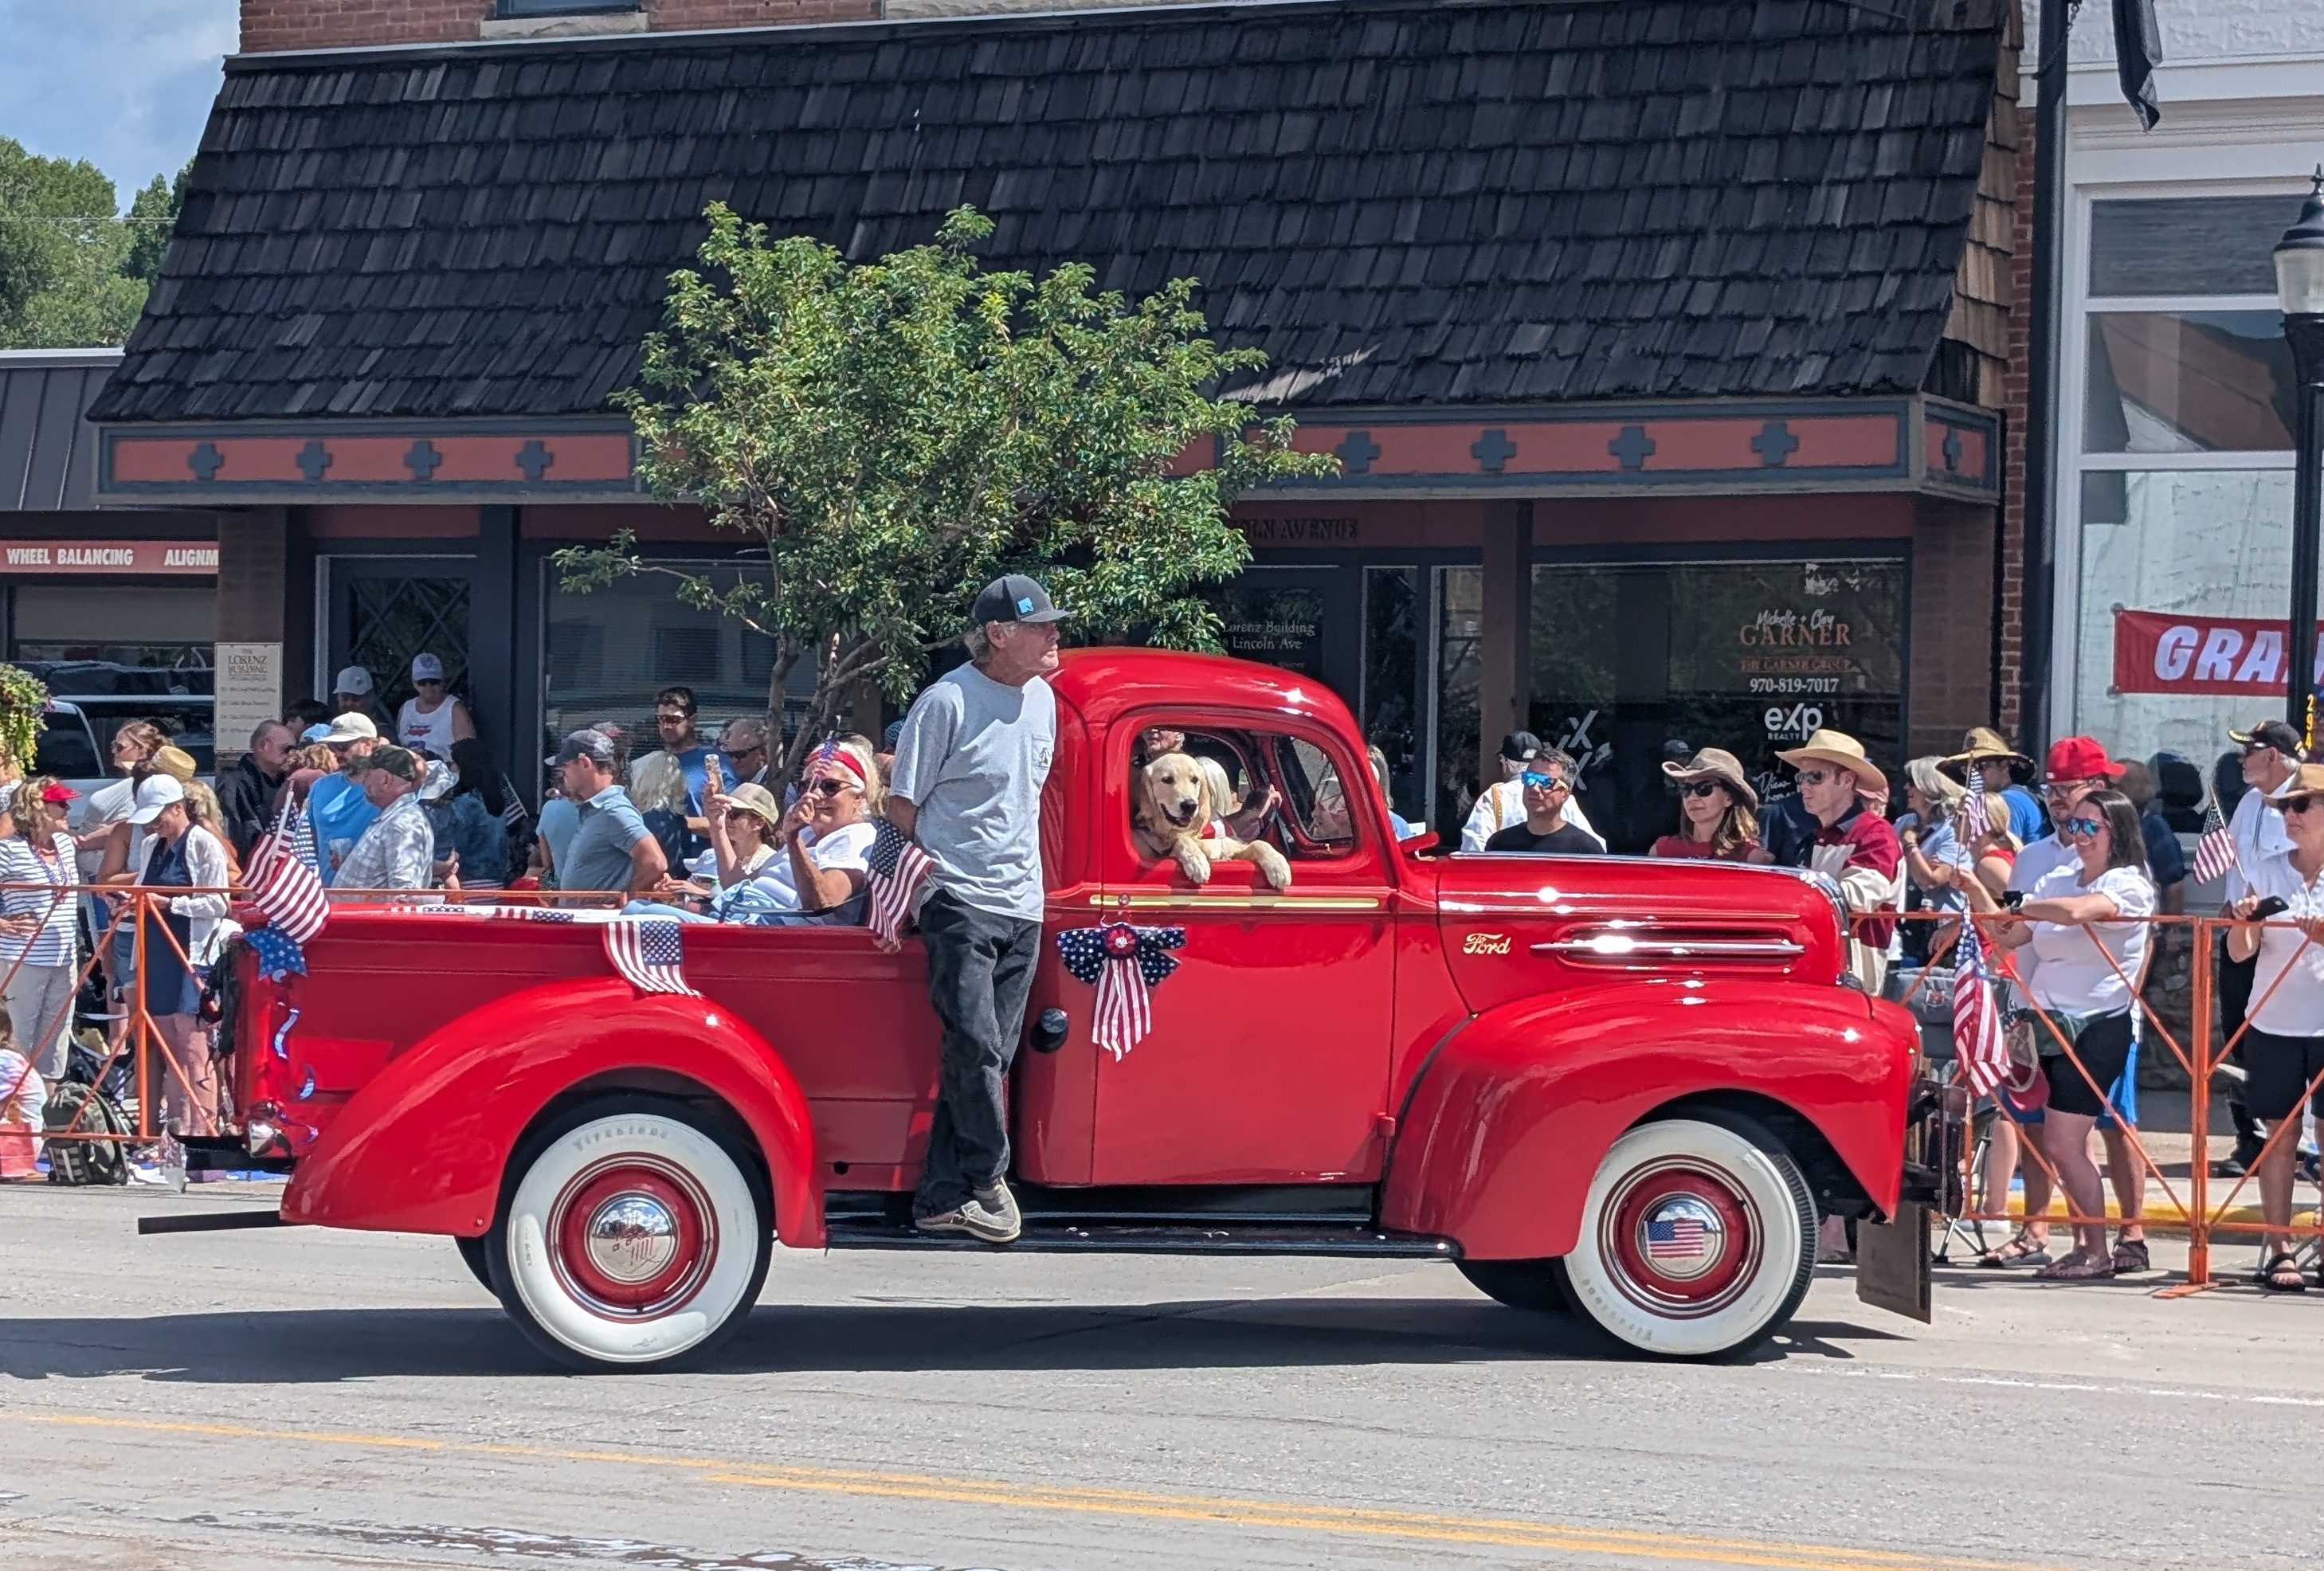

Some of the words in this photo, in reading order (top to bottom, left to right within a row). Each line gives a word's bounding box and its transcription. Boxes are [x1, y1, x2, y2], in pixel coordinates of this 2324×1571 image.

[6, 548, 51, 565] WHEEL
[57, 548, 134, 566] BALANCING
[1223, 622, 1262, 633] Lorenz
[1265, 620, 1316, 637] Building
[1739, 623, 1852, 646] GARNER
[1233, 636, 1276, 650] Lincoln
[1280, 638, 1303, 650] Ave
[2154, 625, 2324, 684] GRA
[1750, 678, 1840, 693] 970-819-7017
[1463, 933, 1511, 954] Ford
